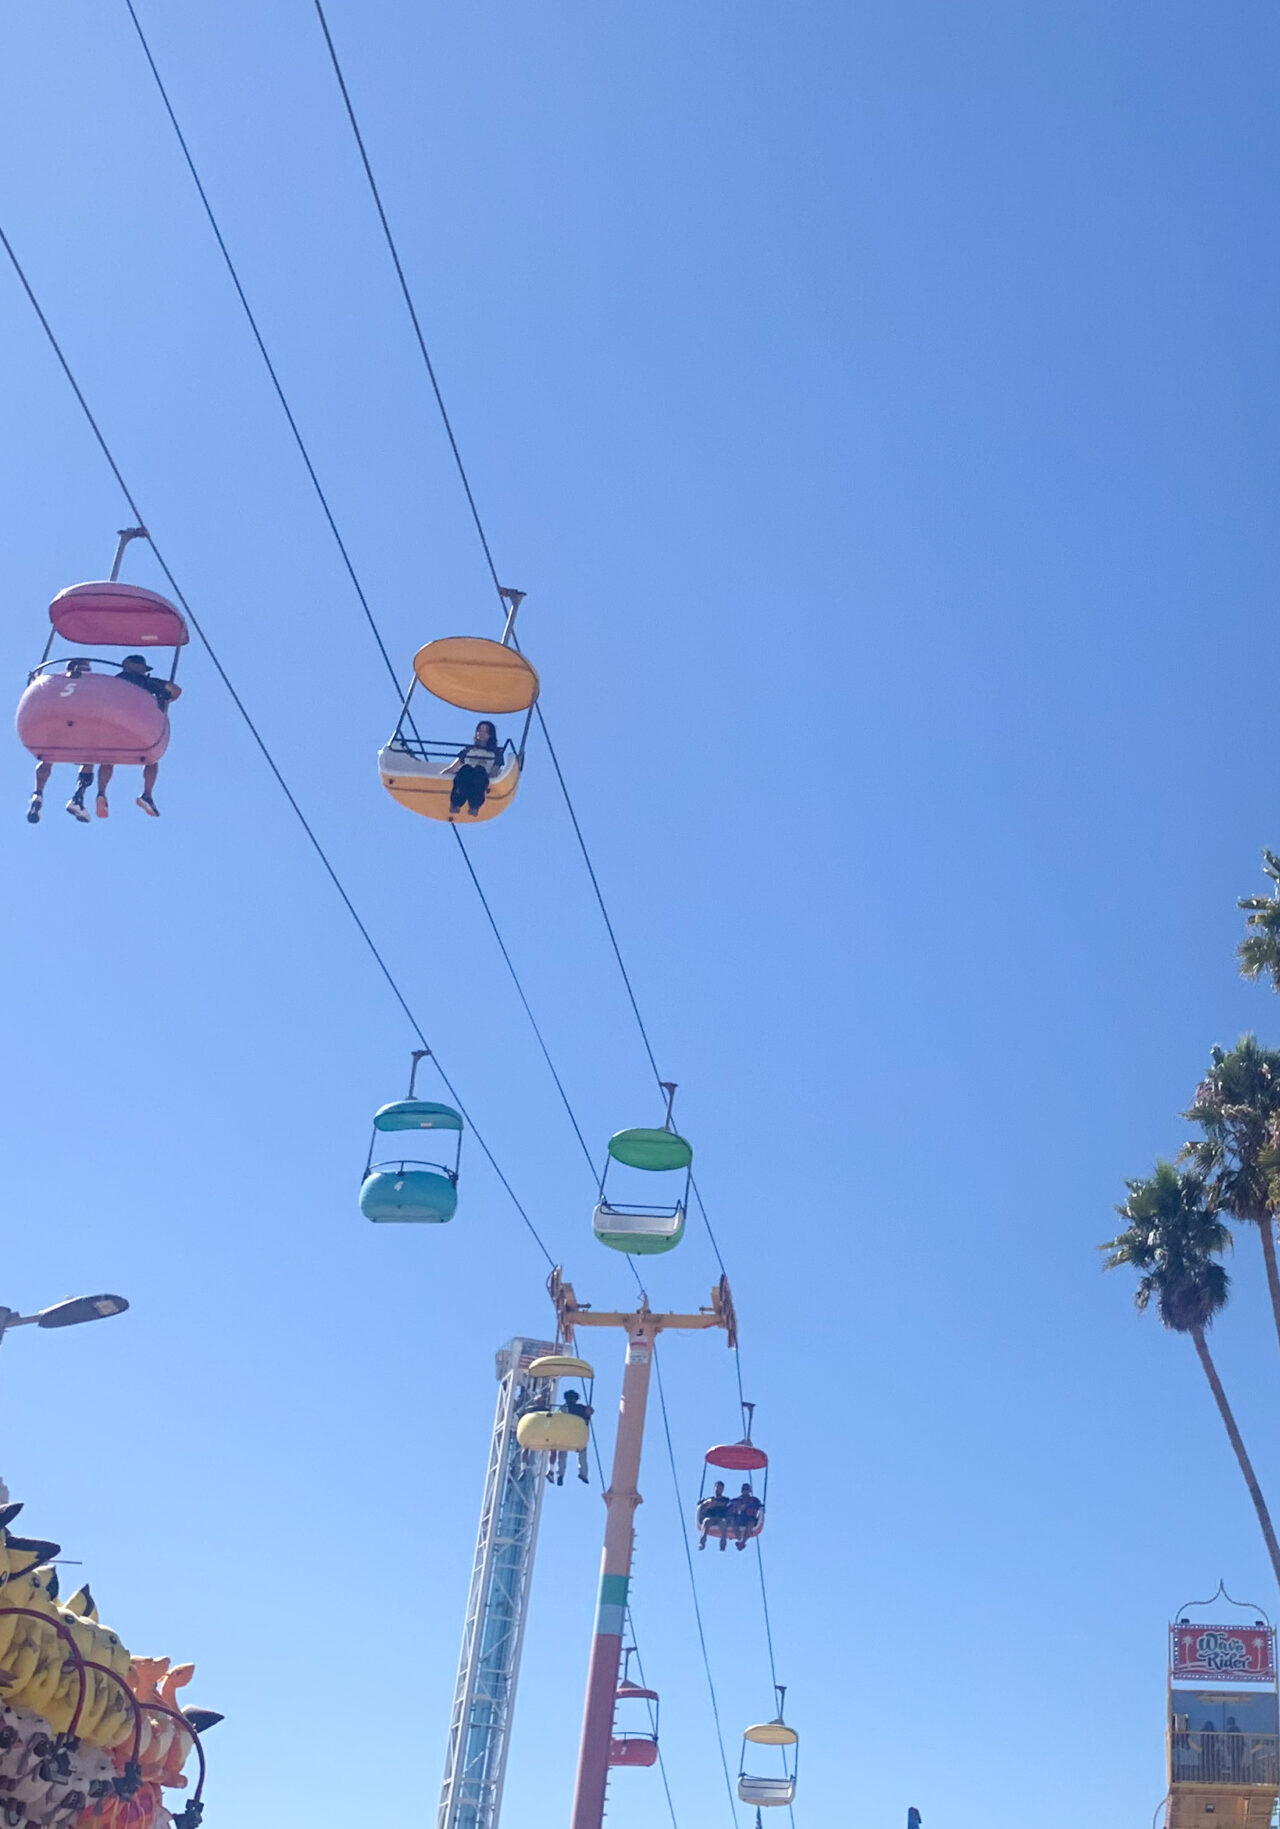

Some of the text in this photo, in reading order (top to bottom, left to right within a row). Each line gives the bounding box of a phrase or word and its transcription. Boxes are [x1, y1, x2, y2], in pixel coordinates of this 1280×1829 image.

[60, 683, 77, 696] 5
[1198, 1632, 1244, 1653] Wave
[1198, 1651, 1251, 1670] Rider
